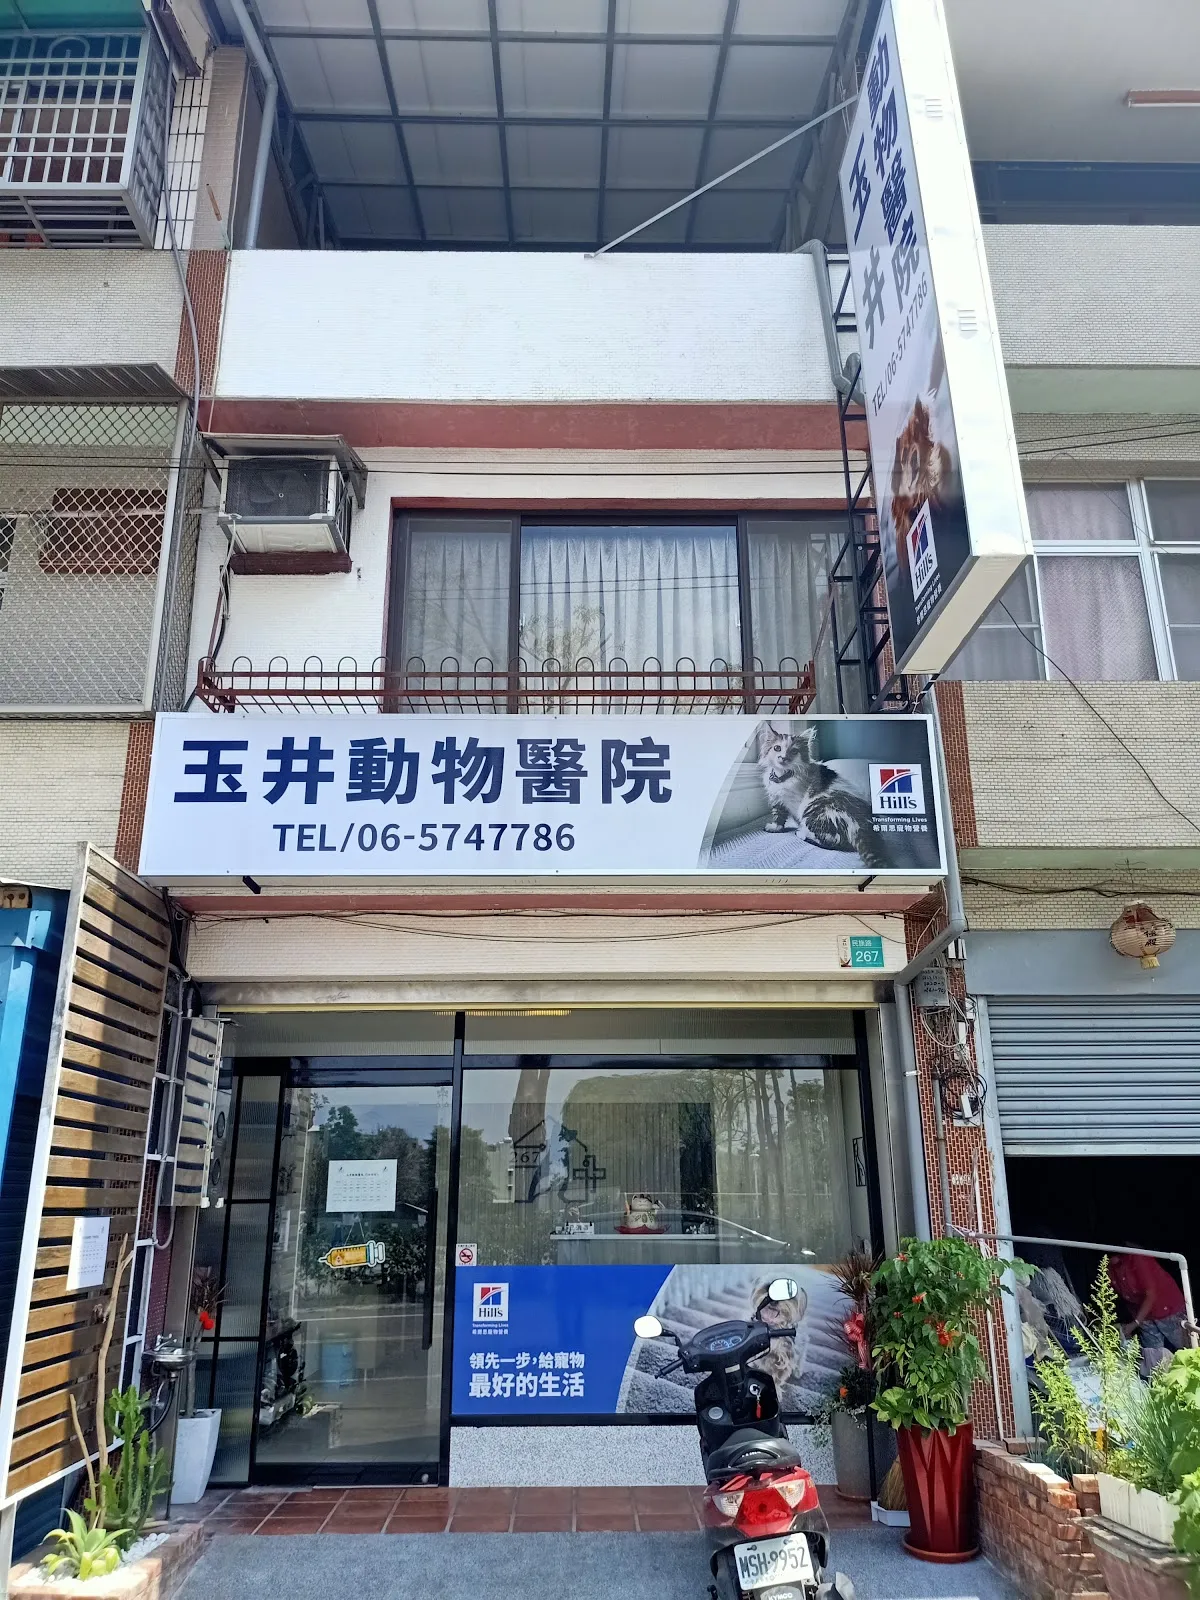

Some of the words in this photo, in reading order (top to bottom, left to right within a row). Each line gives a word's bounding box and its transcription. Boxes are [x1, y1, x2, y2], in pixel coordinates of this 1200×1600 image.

[867, 32, 919, 314] 動物醫院
[849, 133, 885, 349] 玉井
[871, 271, 928, 417] TEL/06-5747786
[914, 552, 934, 589] Hill's
[173, 735, 673, 805] 玉井動物醫院
[879, 796, 918, 809] Hill's
[871, 816, 911, 824] Transforming
[273, 822, 575, 853] TEL/06-5747786
[855, 950, 879, 962] 267
[478, 1307, 504, 1318] Hill's
[468, 1372, 585, 1398] 最好的生活
